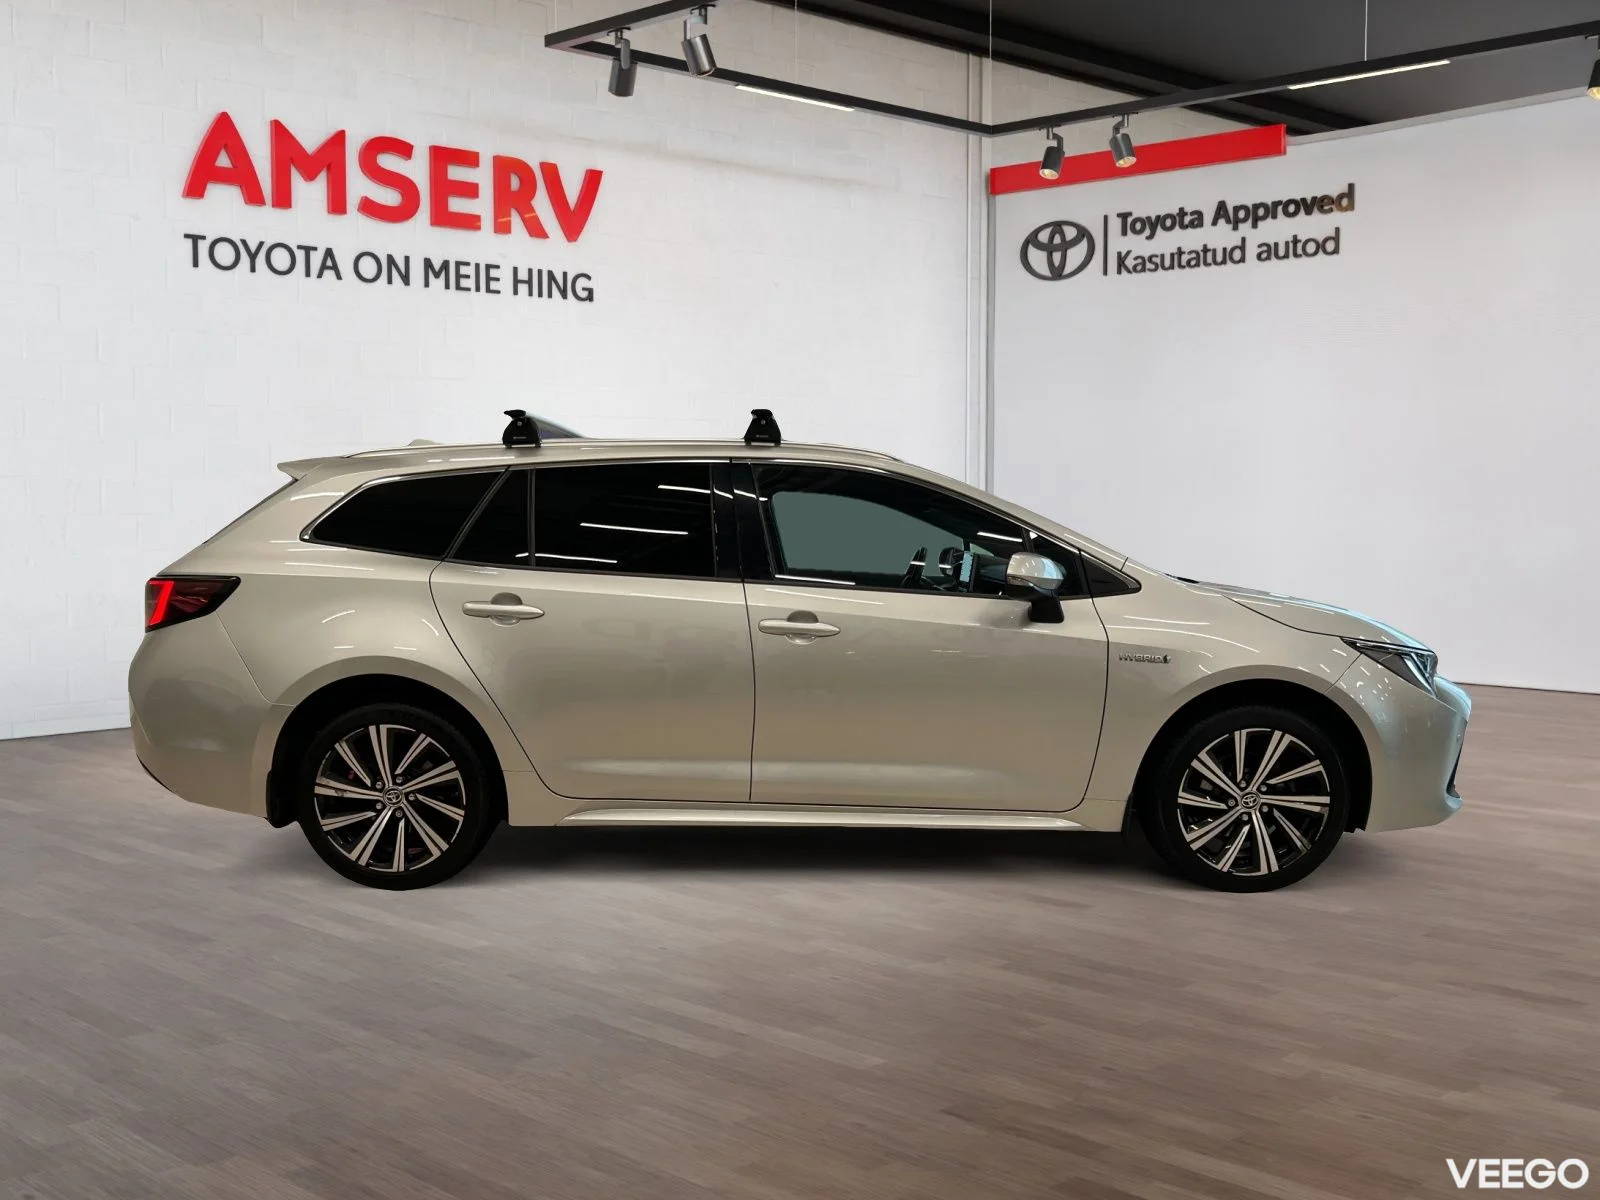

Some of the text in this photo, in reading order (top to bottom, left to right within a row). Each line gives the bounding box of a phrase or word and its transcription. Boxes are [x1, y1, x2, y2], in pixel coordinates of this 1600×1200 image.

[182, 111, 604, 243] AMSERV
[1116, 183, 1356, 240] Toyota Approved
[183, 233, 595, 303] TOYOTA ON MEIE HING
[1116, 227, 1341, 275] Kasutatud autod
[1118, 653, 1164, 664] HYBRID
